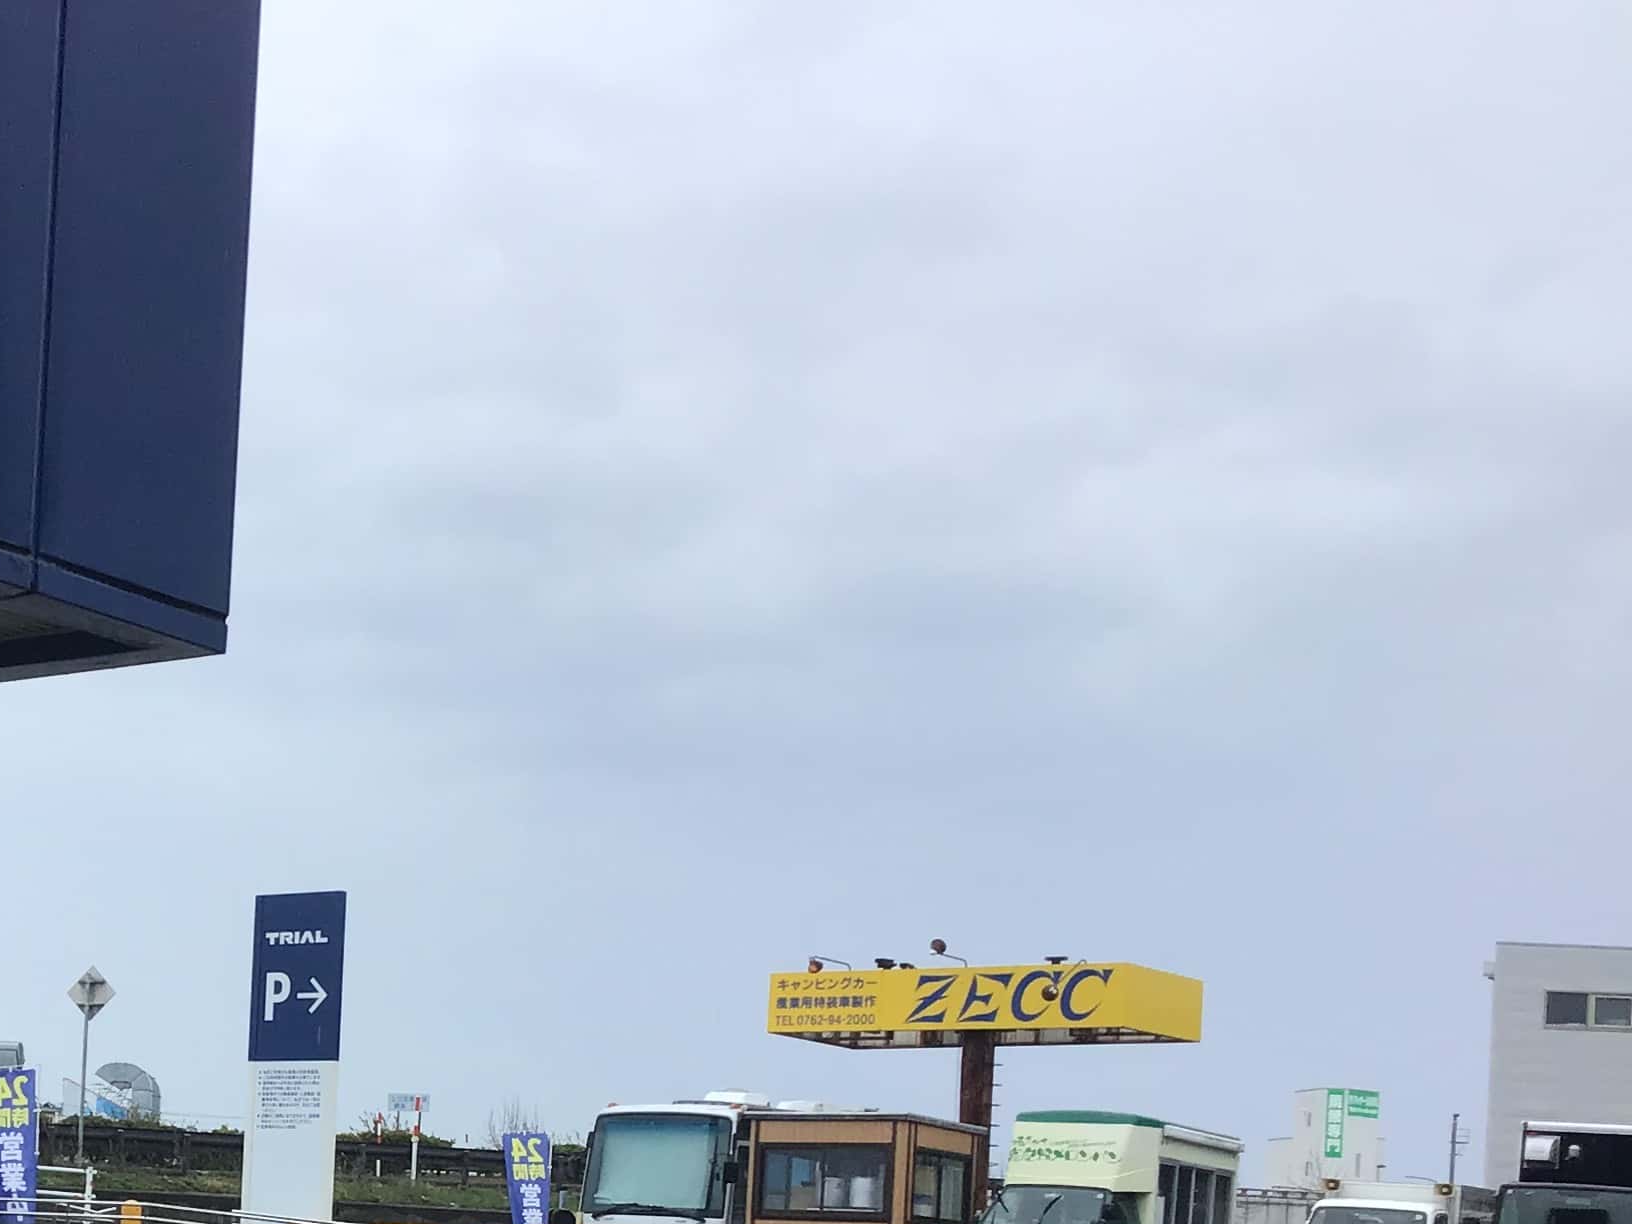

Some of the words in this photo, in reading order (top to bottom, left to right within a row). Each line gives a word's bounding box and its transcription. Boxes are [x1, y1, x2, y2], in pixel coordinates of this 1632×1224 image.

[265, 930, 329, 945] TRIAL
[776, 977, 879, 991] キャンピングカー
[263, 972, 292, 1021] P
[905, 968, 1115, 1024] ZECC
[776, 1015, 794, 1026] TEL
